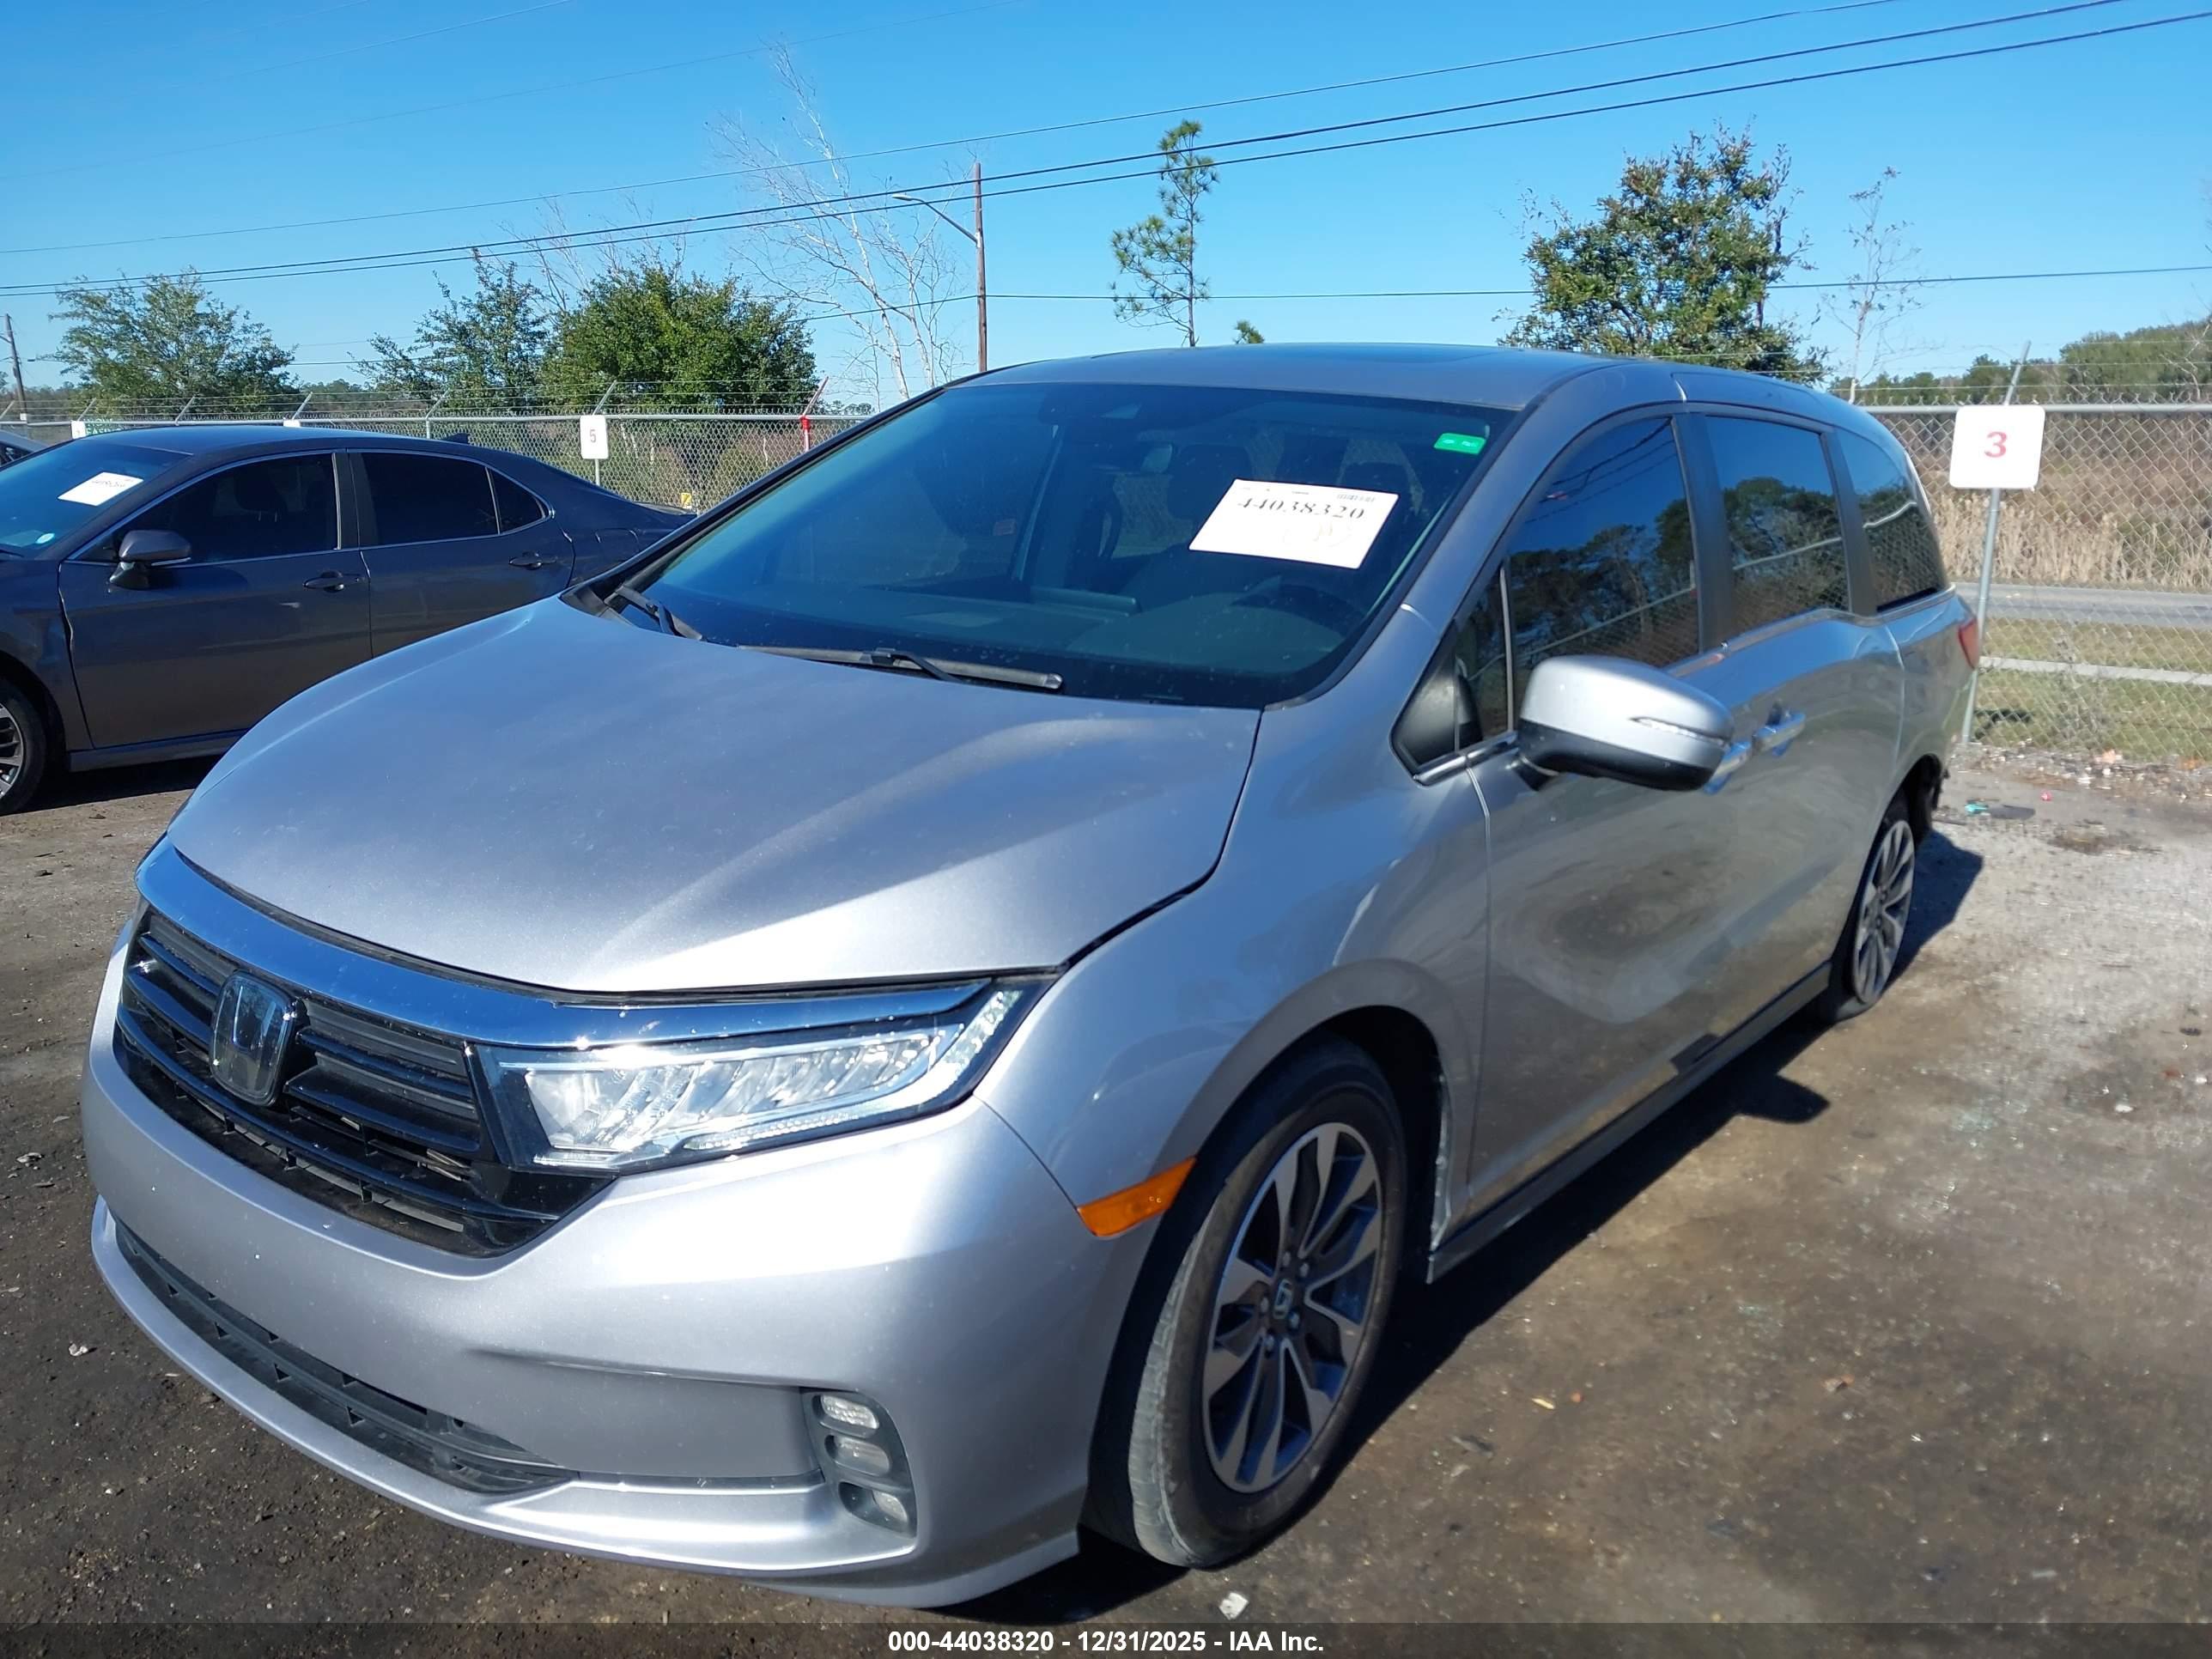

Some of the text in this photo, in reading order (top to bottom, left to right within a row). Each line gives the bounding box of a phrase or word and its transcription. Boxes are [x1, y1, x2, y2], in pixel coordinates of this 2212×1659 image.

[589, 428, 597, 443] 5
[1984, 430, 2008, 459] 3
[1237, 497, 1365, 520] 44038320
